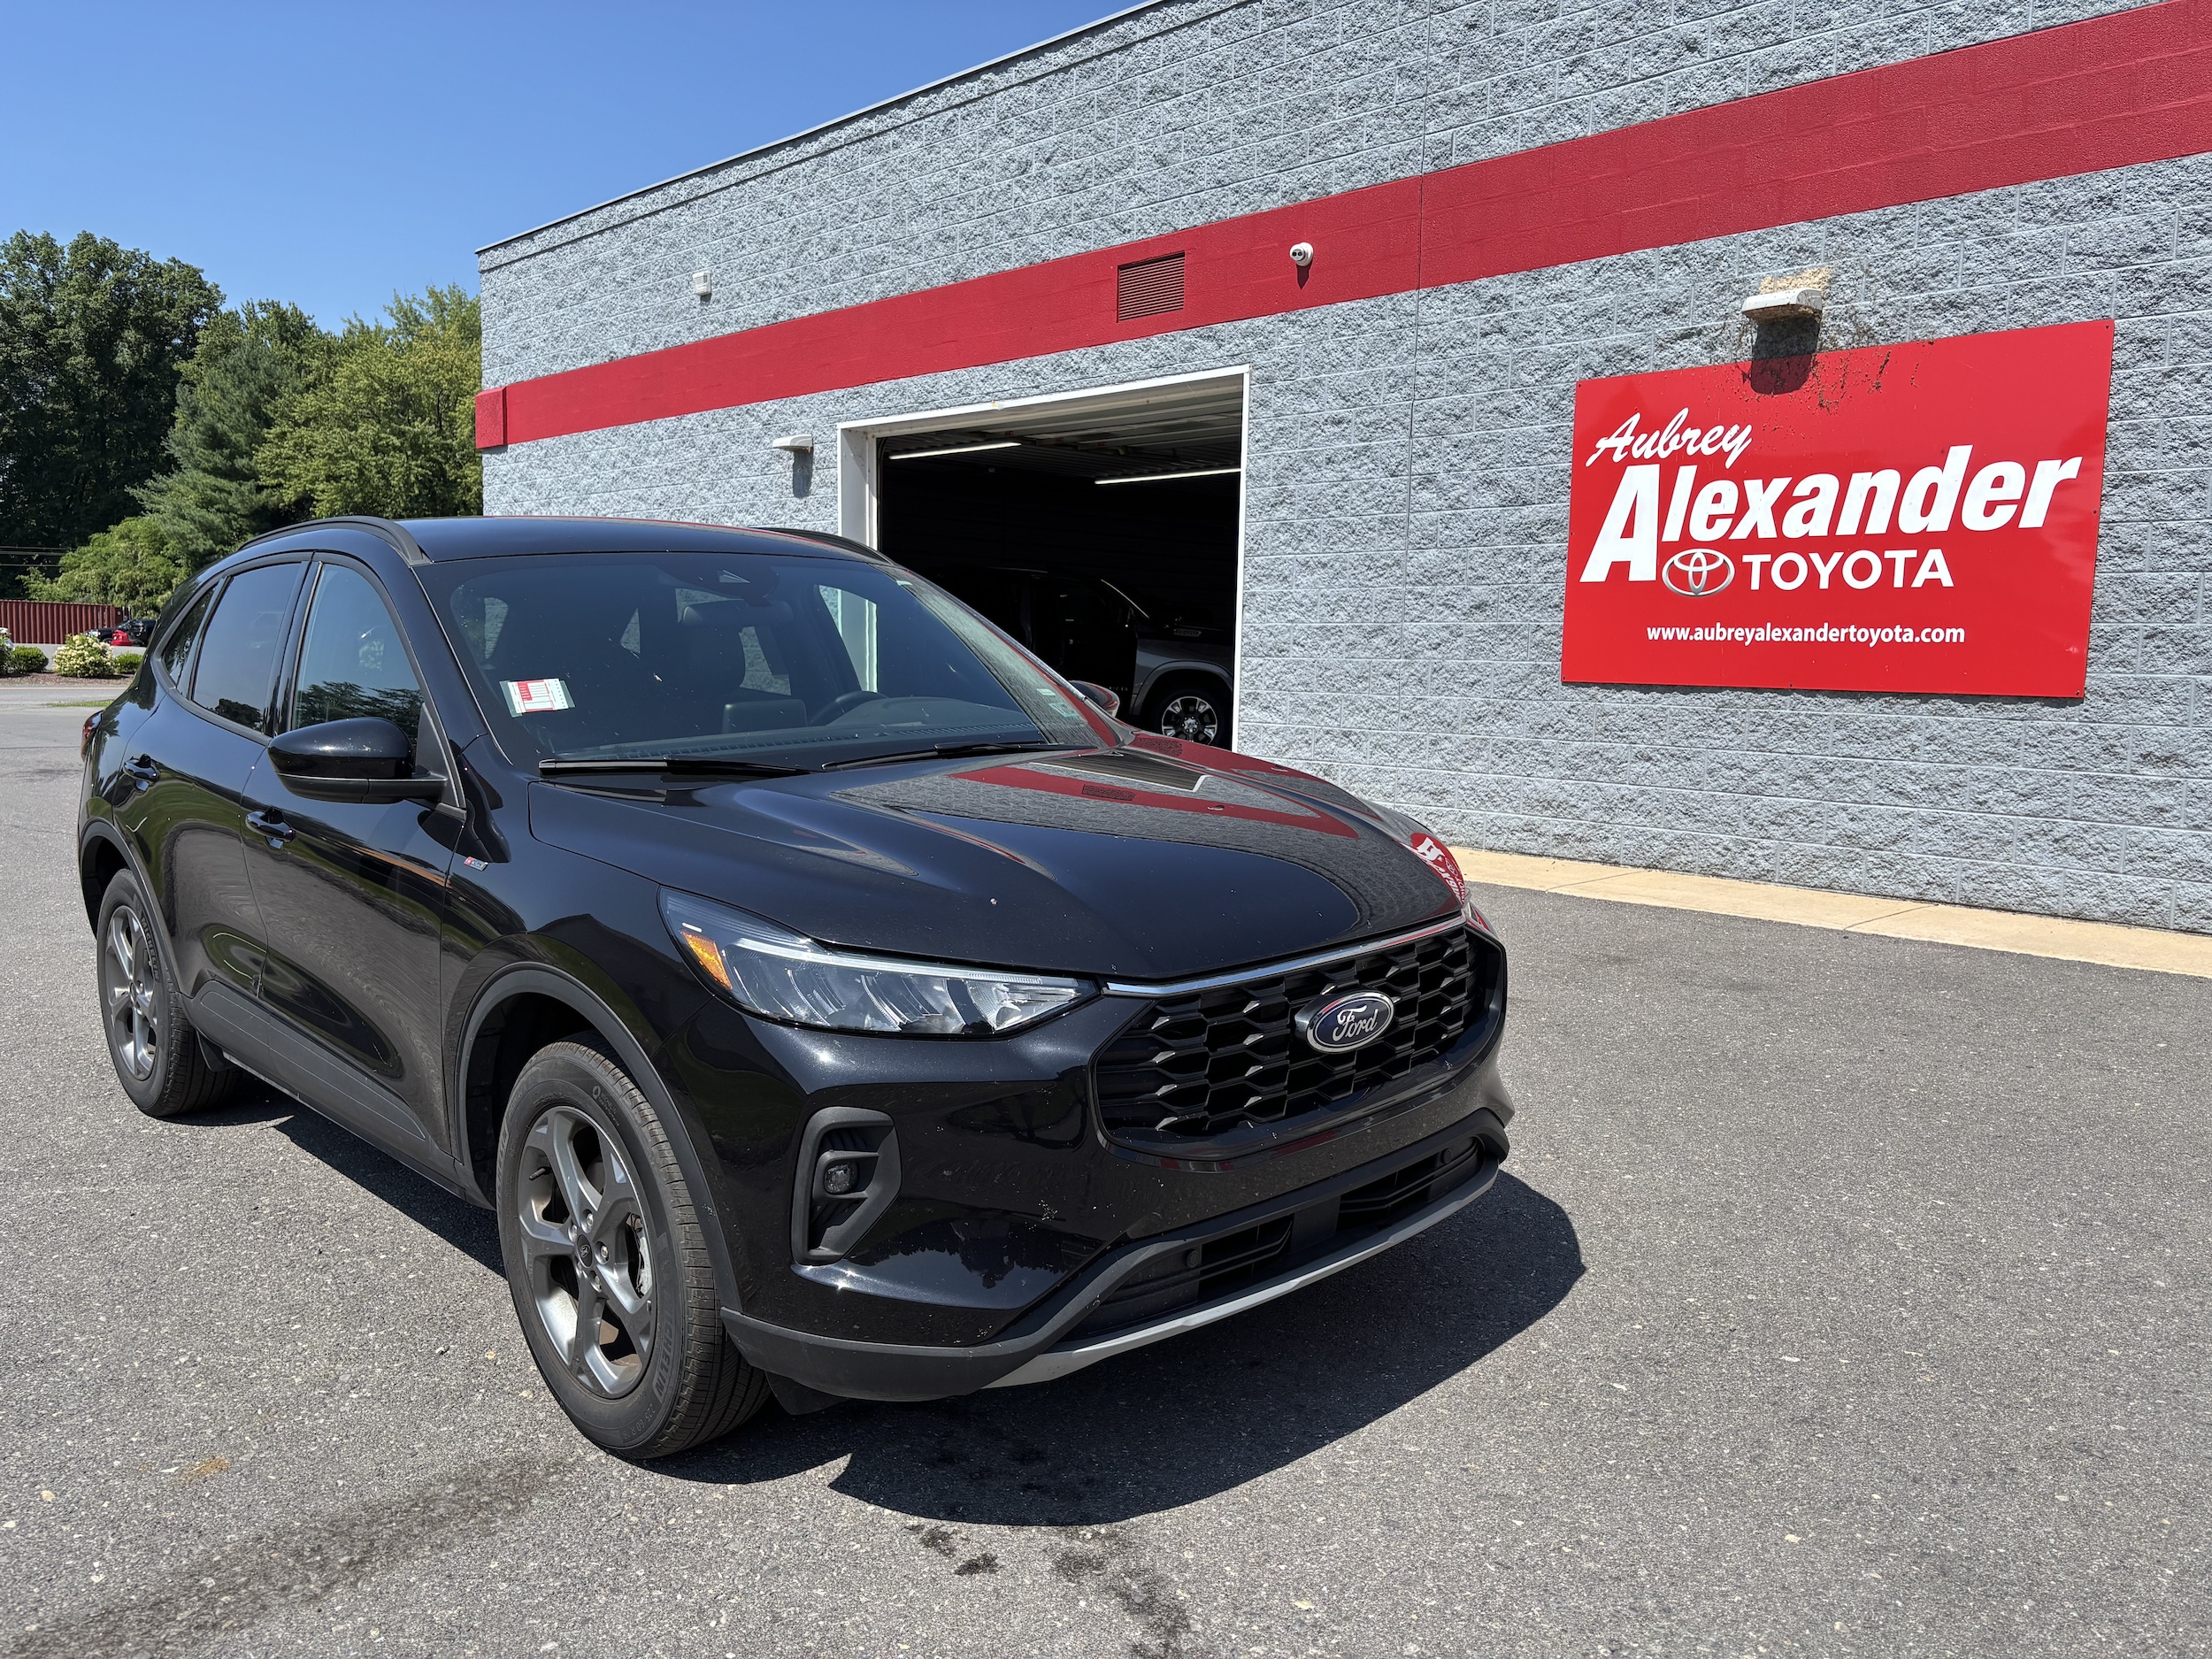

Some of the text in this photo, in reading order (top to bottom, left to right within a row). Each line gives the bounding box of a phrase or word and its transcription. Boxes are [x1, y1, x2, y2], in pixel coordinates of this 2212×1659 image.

[1585, 407, 1753, 469] Aubrey
[1578, 444, 2083, 583] Alexander
[1741, 548, 1955, 591] TOYOTA
[1647, 621, 1965, 648] www.aubreyalexandertoyota.com
[141, 915, 160, 979] MICHELIN
[1332, 1005, 1379, 1041] Ford
[655, 1289, 673, 1396] MICHELIN
